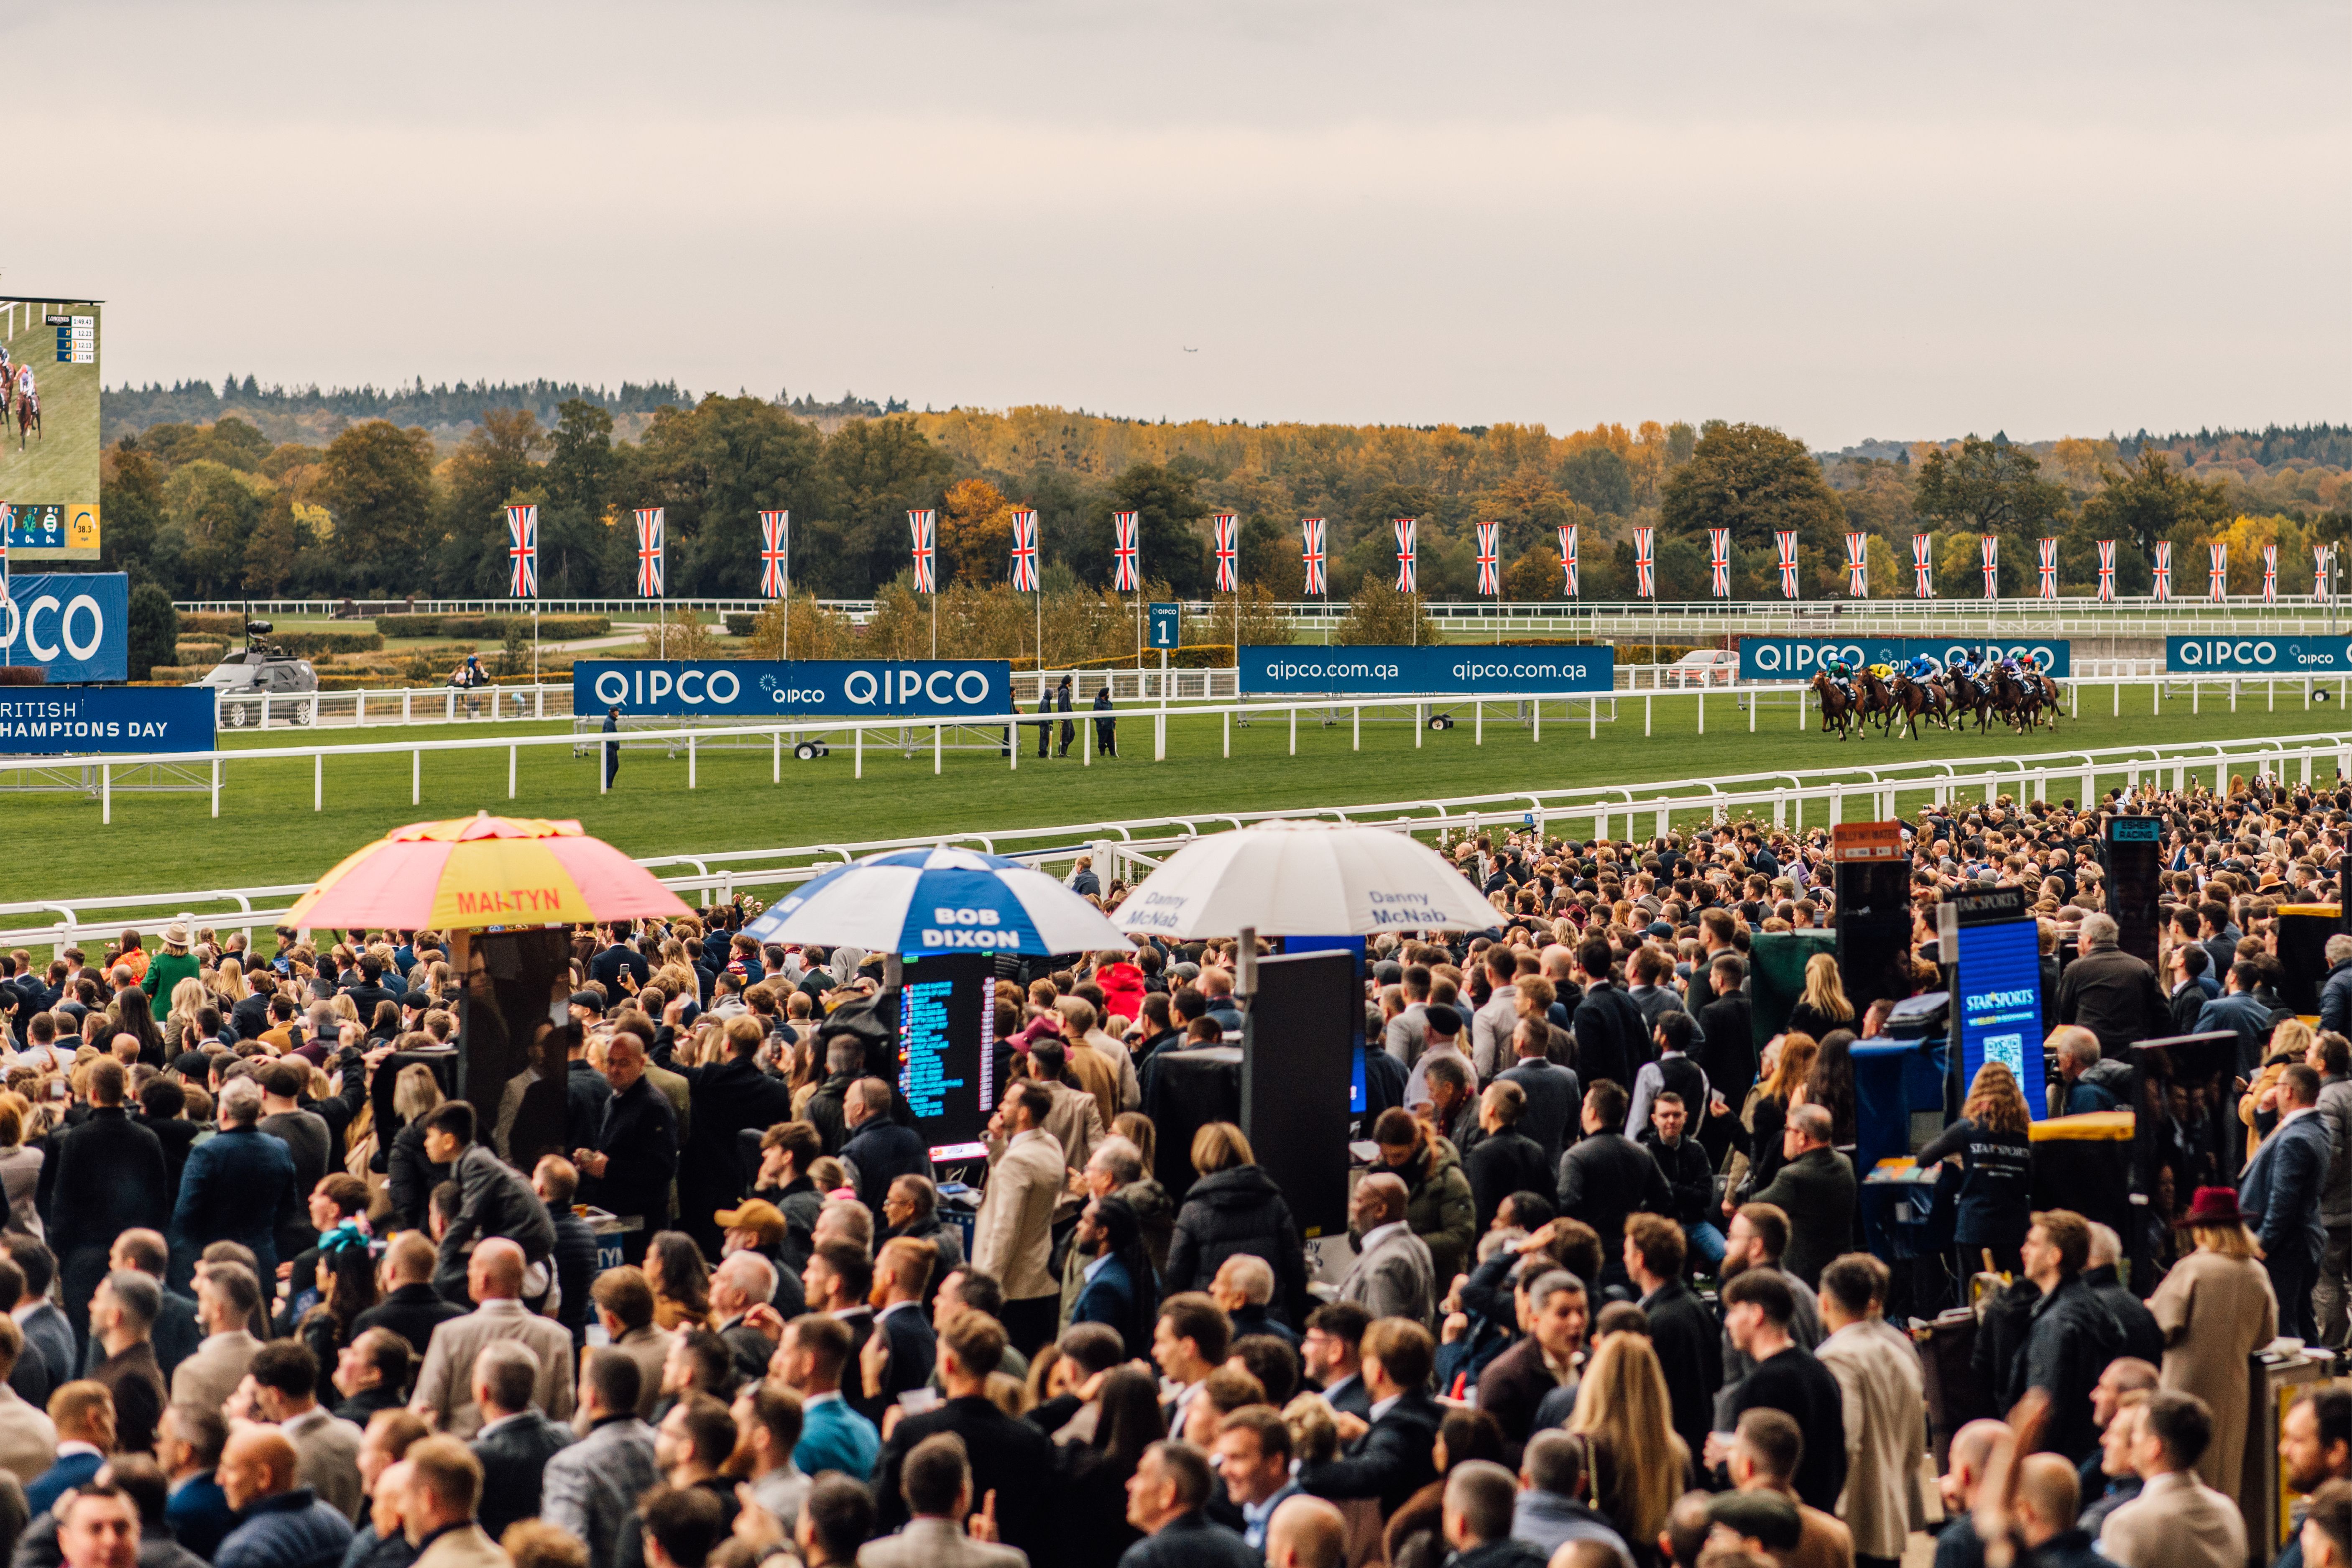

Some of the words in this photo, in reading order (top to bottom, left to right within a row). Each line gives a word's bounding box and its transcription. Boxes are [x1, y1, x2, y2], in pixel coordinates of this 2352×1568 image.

[1157, 620, 1170, 644] 1
[2180, 641, 2276, 666] QIPCO
[2298, 654, 2334, 664] QIPCO
[1267, 661, 1398, 680] qipco.com.qa
[1453, 661, 1586, 680] qipco.com.qa
[595, 670, 740, 706] QIPCO
[773, 689, 825, 703] QIPCO
[844, 670, 989, 706] QIPCO
[0, 702, 76, 718] RITISH
[0, 722, 120, 737] HAMPIONS
[128, 722, 167, 737] DAY
[2121, 821, 2150, 829] ESHER
[1145, 892, 1187, 908] Danny
[1369, 891, 1428, 905] Danny
[935, 907, 1001, 926] BOB
[1126, 910, 1179, 927] McNab
[1372, 909, 1447, 924] McNab
[922, 929, 1020, 949] DIXON
[1966, 994, 1994, 1011] STAR
[1995, 988, 2035, 1009] SPORTS
[1970, 1143, 1994, 1154] STAR
